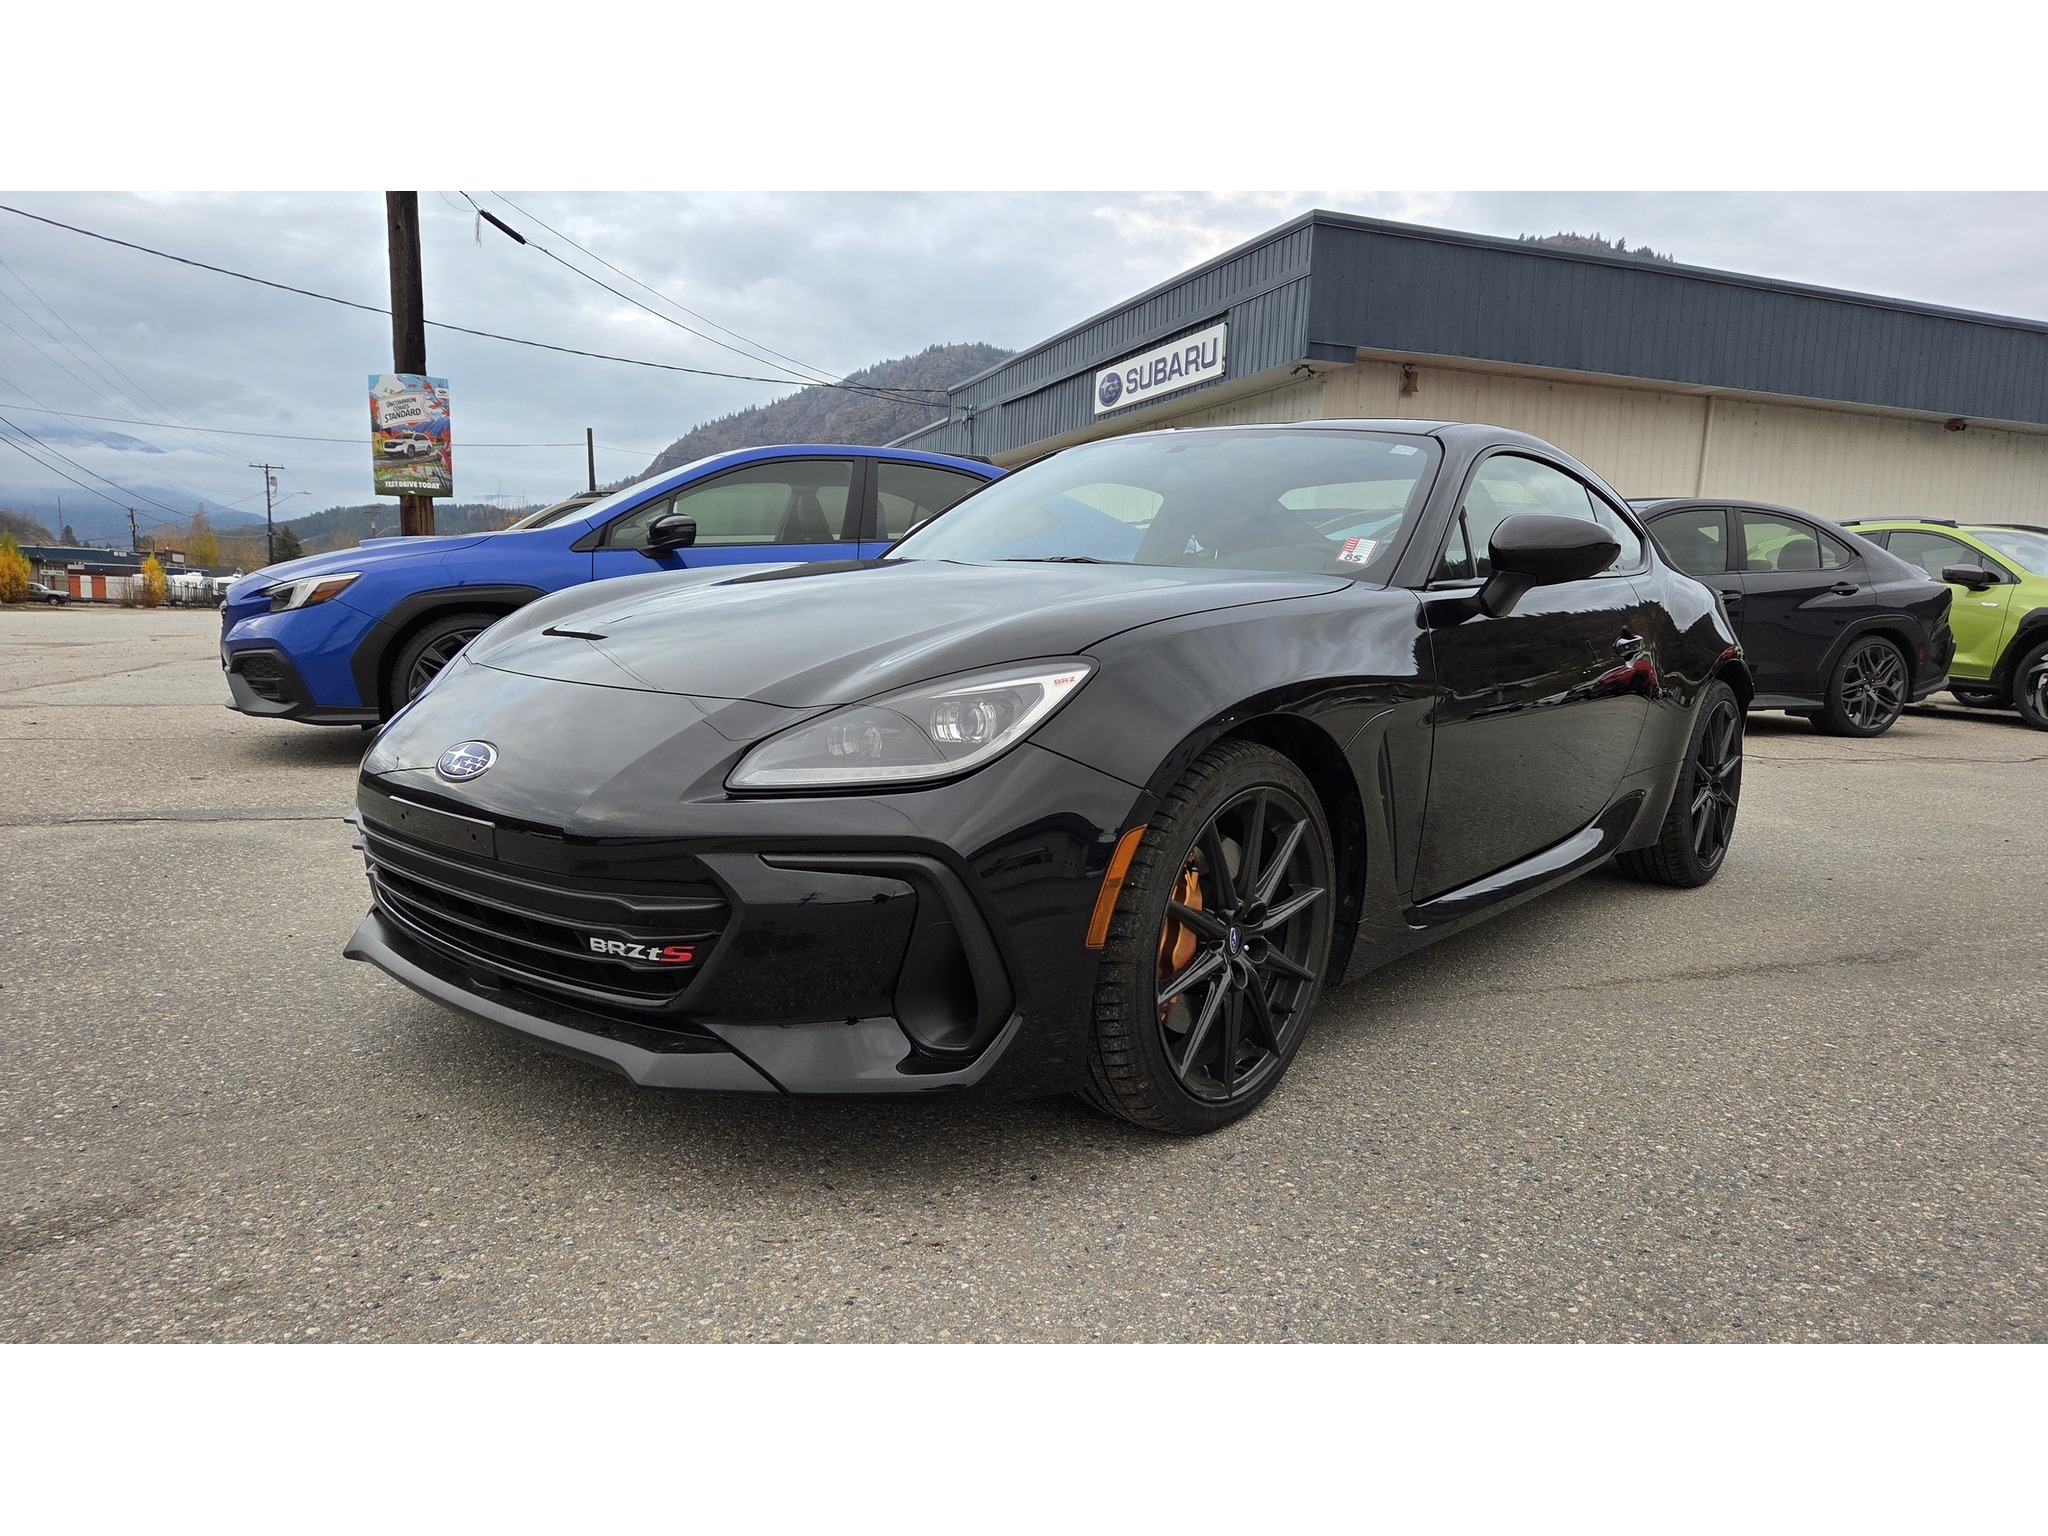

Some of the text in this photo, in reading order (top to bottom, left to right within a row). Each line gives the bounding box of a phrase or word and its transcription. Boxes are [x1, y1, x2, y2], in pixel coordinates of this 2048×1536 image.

[1126, 337, 1218, 395] SUBARU
[385, 397, 417, 408] UNCOMMON
[393, 403, 410, 412] COMES
[384, 408, 421, 423] STANDARD
[418, 481, 440, 489] TODAY
[1053, 676, 1076, 685] BRZ
